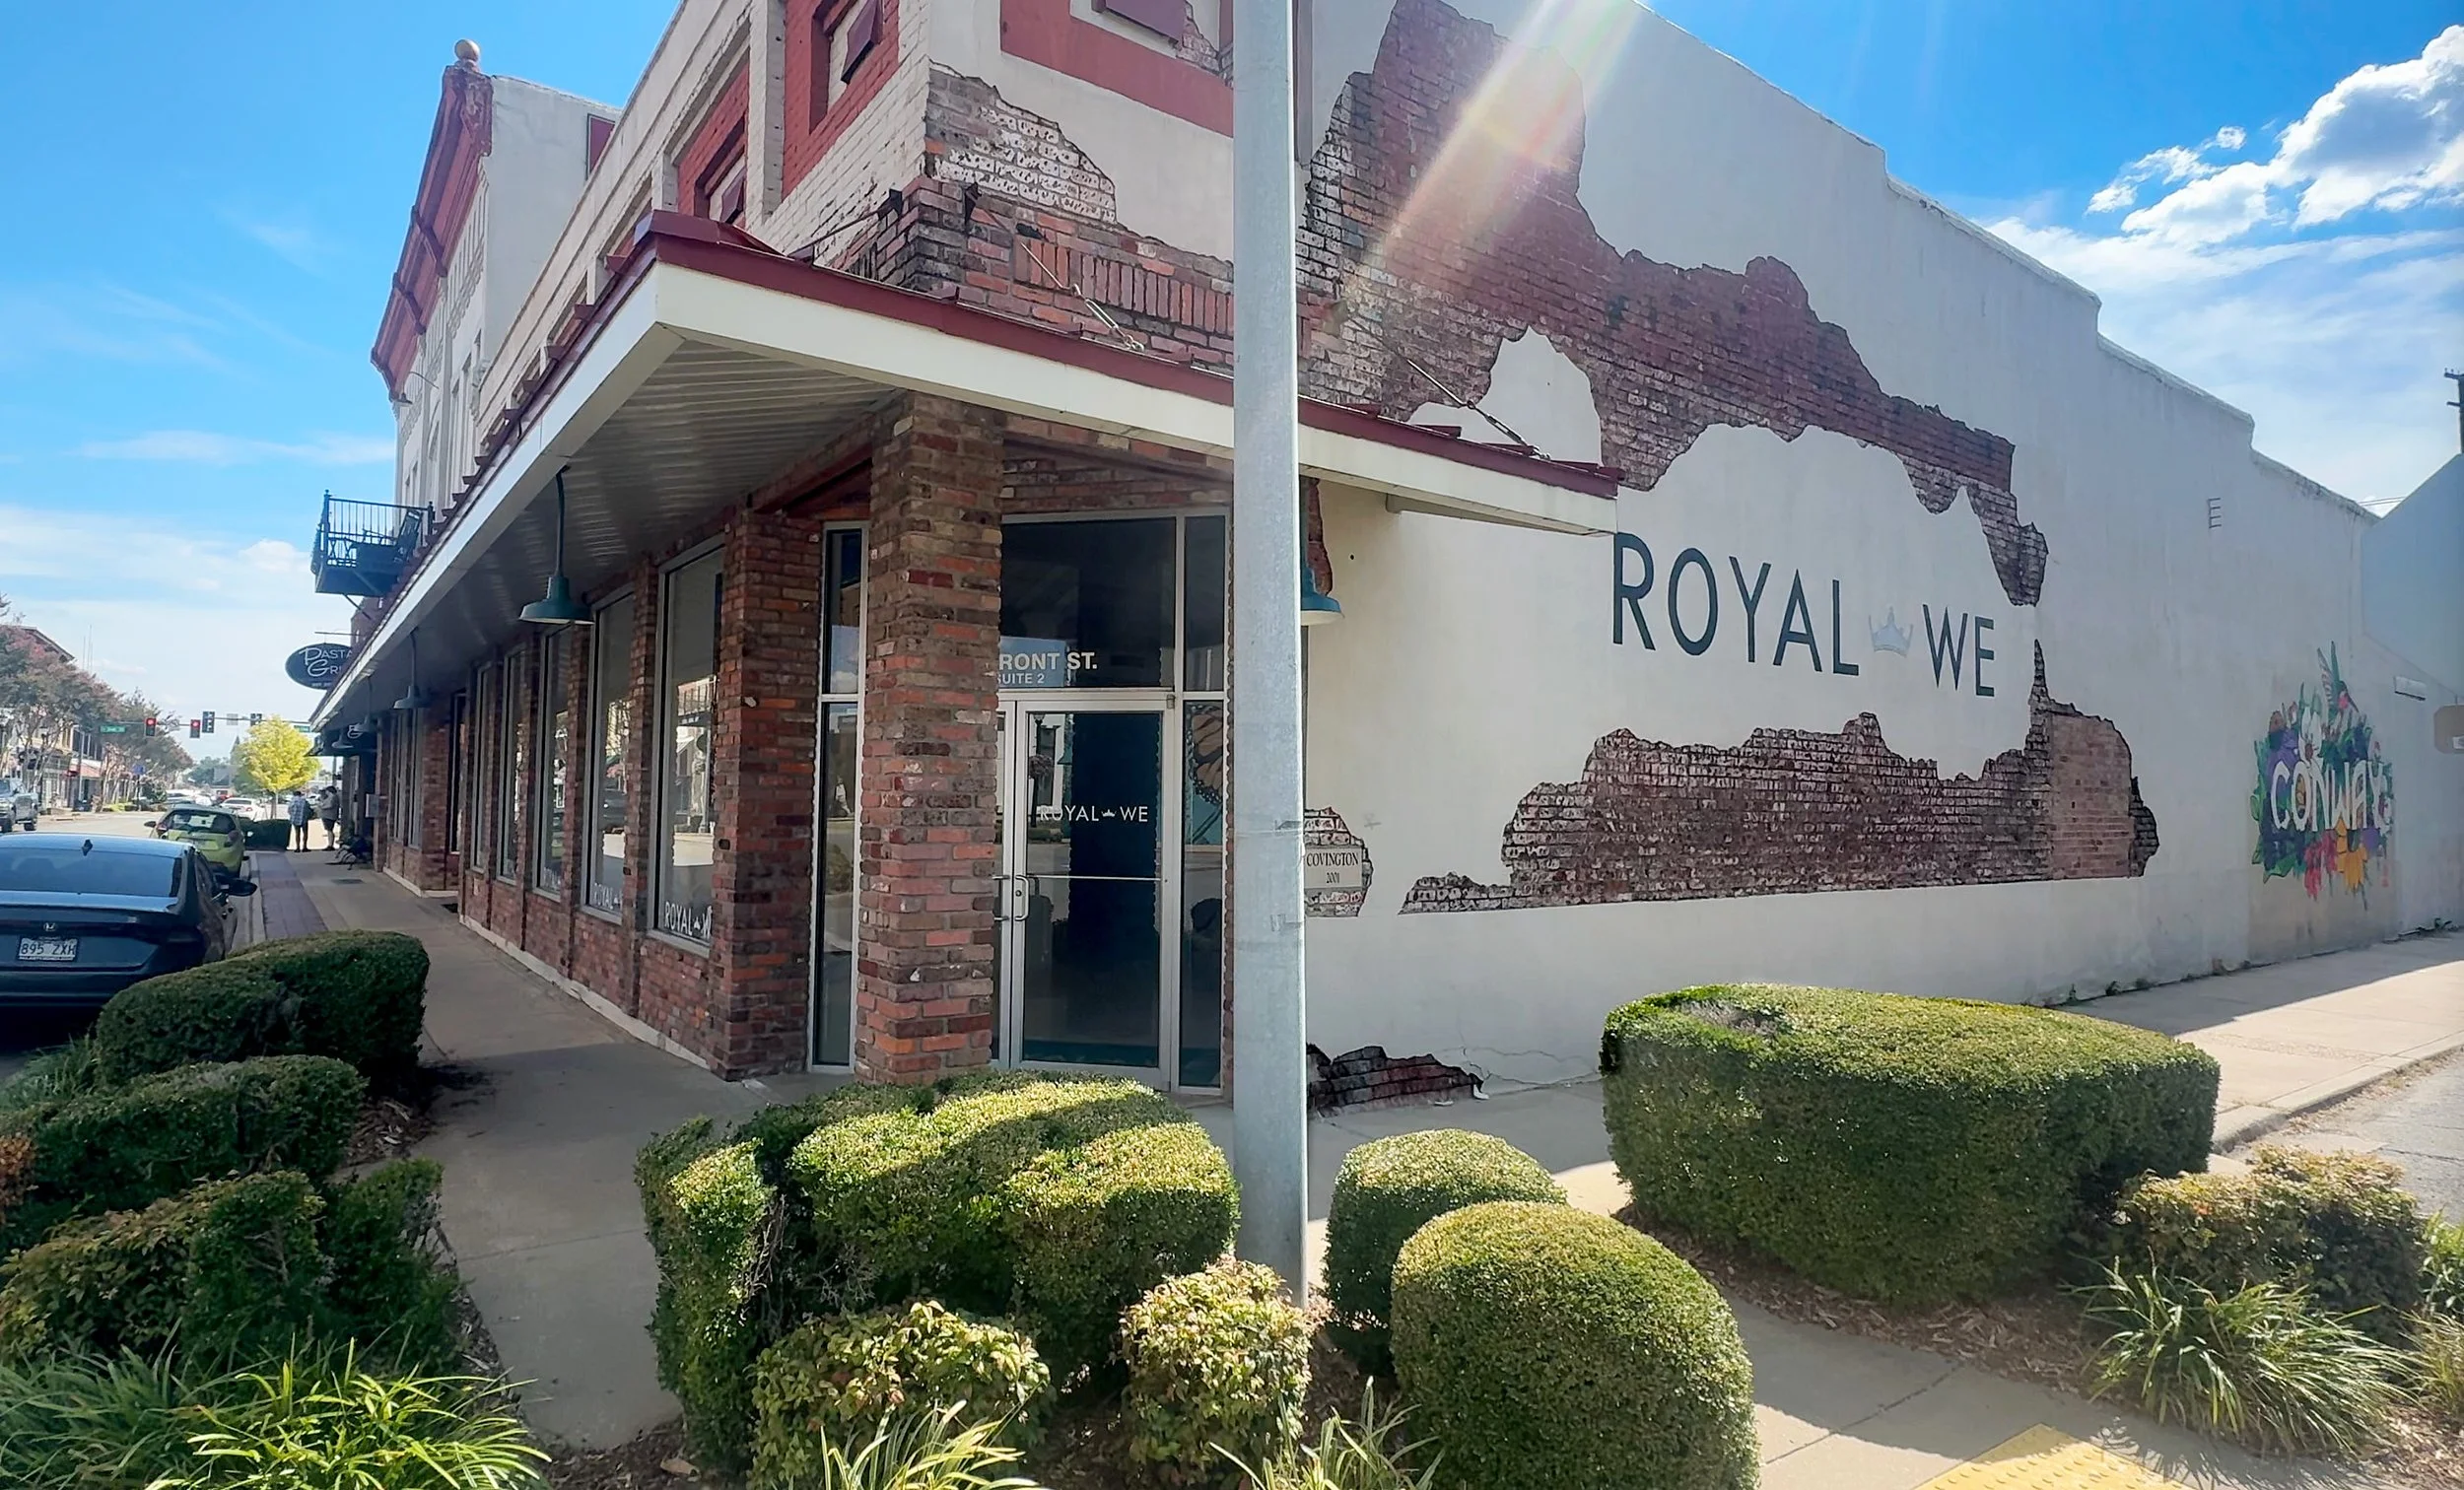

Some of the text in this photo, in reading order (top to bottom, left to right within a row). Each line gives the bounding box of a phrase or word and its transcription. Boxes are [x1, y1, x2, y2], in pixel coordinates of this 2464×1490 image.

[1613, 532, 1995, 697] ROYAL WE
[998, 651, 1098, 670] RONT ST.
[1037, 672, 1045, 684] 2
[2271, 759, 2387, 836] CONWAY
[1040, 804, 1148, 822] ROYAL WE
[1306, 852, 1359, 866] COVINGTON
[664, 901, 693, 936] ROYAL
[21, 943, 44, 955] 895
